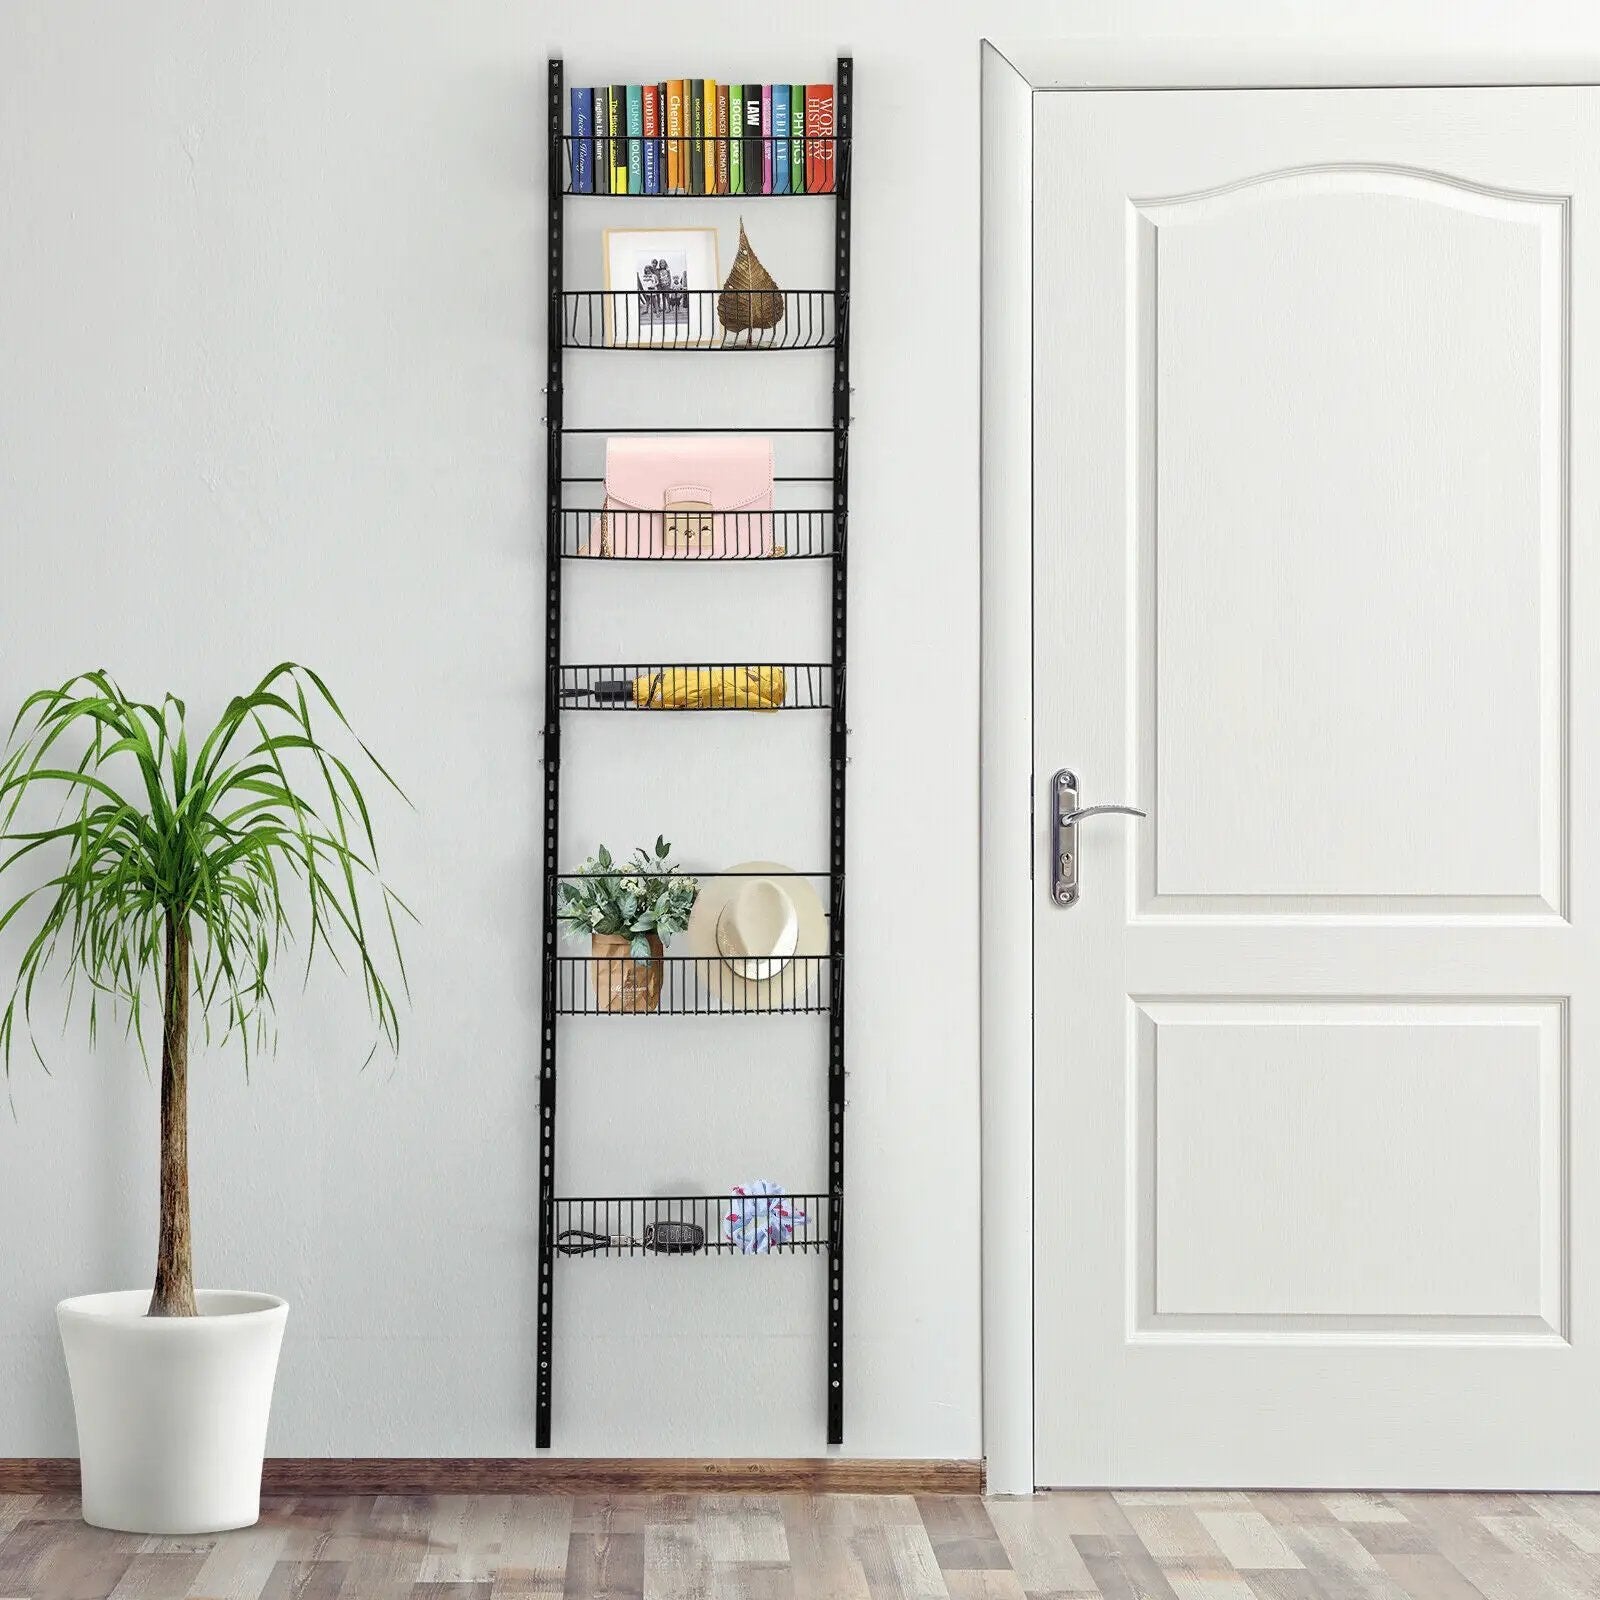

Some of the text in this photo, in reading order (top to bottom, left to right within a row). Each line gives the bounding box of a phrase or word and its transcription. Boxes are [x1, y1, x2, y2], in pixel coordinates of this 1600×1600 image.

[577, 107, 588, 140] Ancien
[595, 97, 603, 124] English
[631, 98, 640, 135] HUMAN
[644, 92, 655, 136] MODERN
[747, 100, 760, 126] LAW
[819, 97, 833, 161] WORLD
